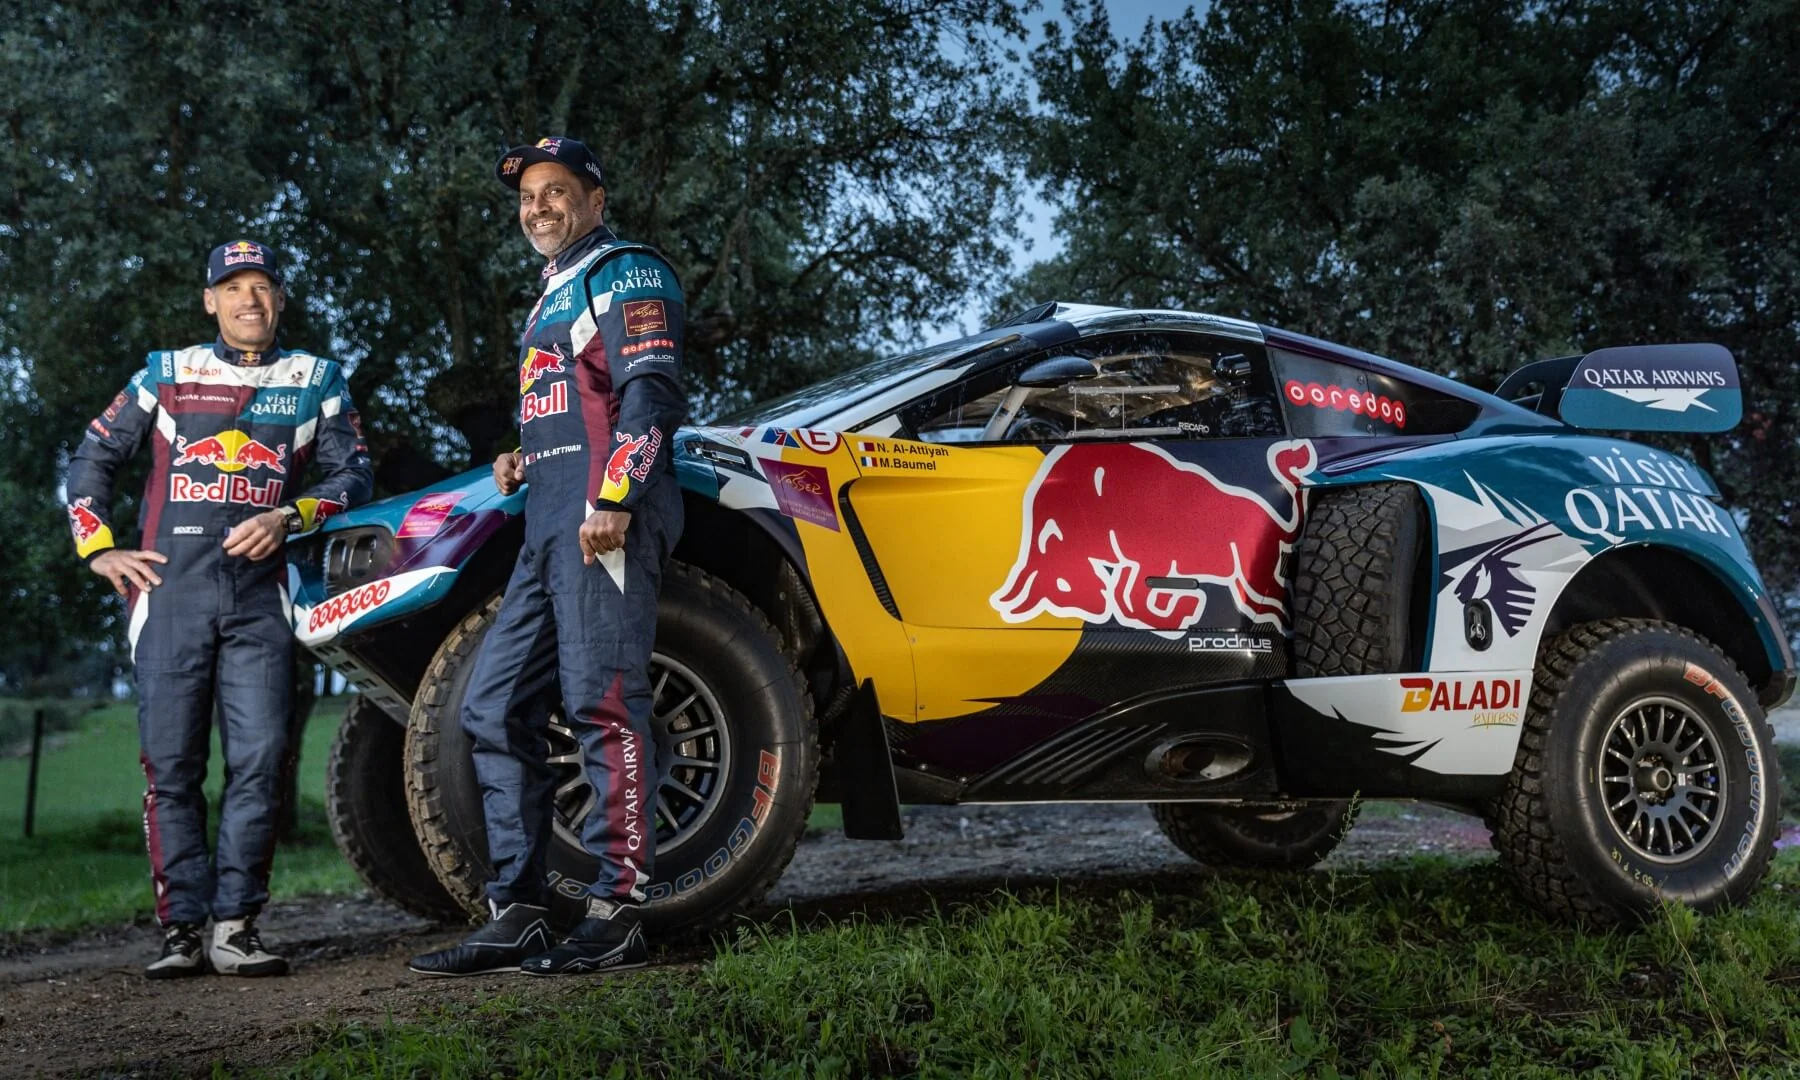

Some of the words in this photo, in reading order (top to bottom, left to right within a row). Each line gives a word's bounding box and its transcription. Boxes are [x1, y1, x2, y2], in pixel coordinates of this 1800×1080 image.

[626, 266, 661, 279] visit
[612, 277, 663, 293] QATAR
[541, 296, 572, 321] QATAR
[622, 339, 675, 355] ooredoo
[1584, 368, 1649, 388] QATAR
[1652, 370, 1726, 386] AIRWAYS
[265, 393, 298, 405] visit
[523, 380, 568, 424] Bull
[1286, 381, 1405, 427] ooredoo
[250, 403, 297, 416] QATAR
[1178, 421, 1210, 433] RECARO
[631, 450, 655, 483] Red
[643, 426, 662, 458] Bull
[877, 443, 890, 453] N.
[893, 443, 949, 458] Al-Attiyah
[880, 457, 937, 471] M.Baumel
[1589, 447, 1699, 493] visit
[171, 473, 228, 503] Red
[229, 475, 284, 508] Bull
[1564, 487, 1731, 544] QATAR
[309, 580, 391, 633] ooredoo
[1188, 634, 1273, 652] prodrive
[1399, 678, 1521, 713] BALADI
[1472, 711, 1520, 729] express
[624, 786, 642, 851] QATAR
